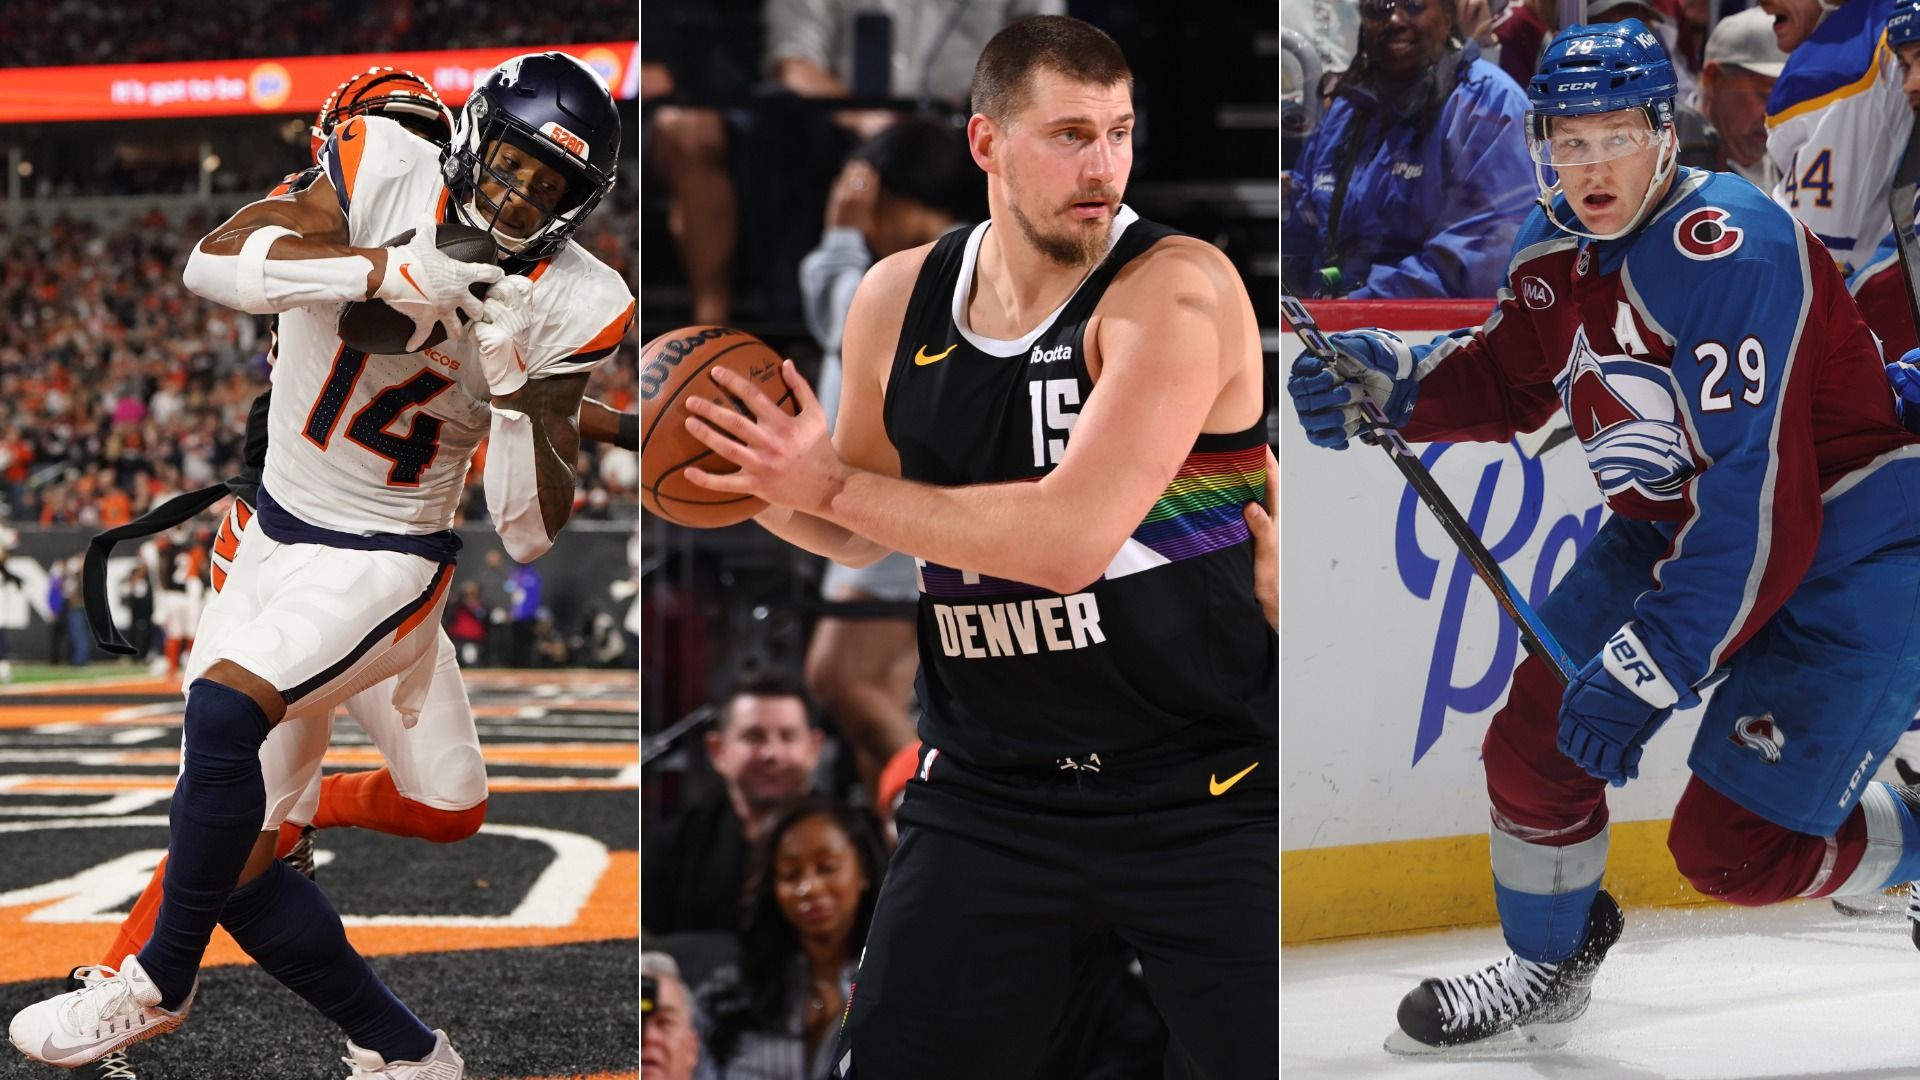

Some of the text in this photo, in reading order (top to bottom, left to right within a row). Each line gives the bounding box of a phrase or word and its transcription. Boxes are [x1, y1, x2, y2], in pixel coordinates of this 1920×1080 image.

[1566, 39, 1595, 56] 29
[1557, 81, 1599, 93] CCM
[550, 125, 585, 156] 5280
[1784, 147, 1834, 209] 44
[1524, 281, 1547, 303] IMA
[1030, 344, 1072, 364] ibotta
[1611, 299, 1650, 356] A
[1692, 336, 1768, 412] 29
[301, 340, 457, 487] 14
[1029, 378, 1081, 467] 15
[933, 591, 1107, 659] DENVER
[1838, 749, 1874, 808] CCM
